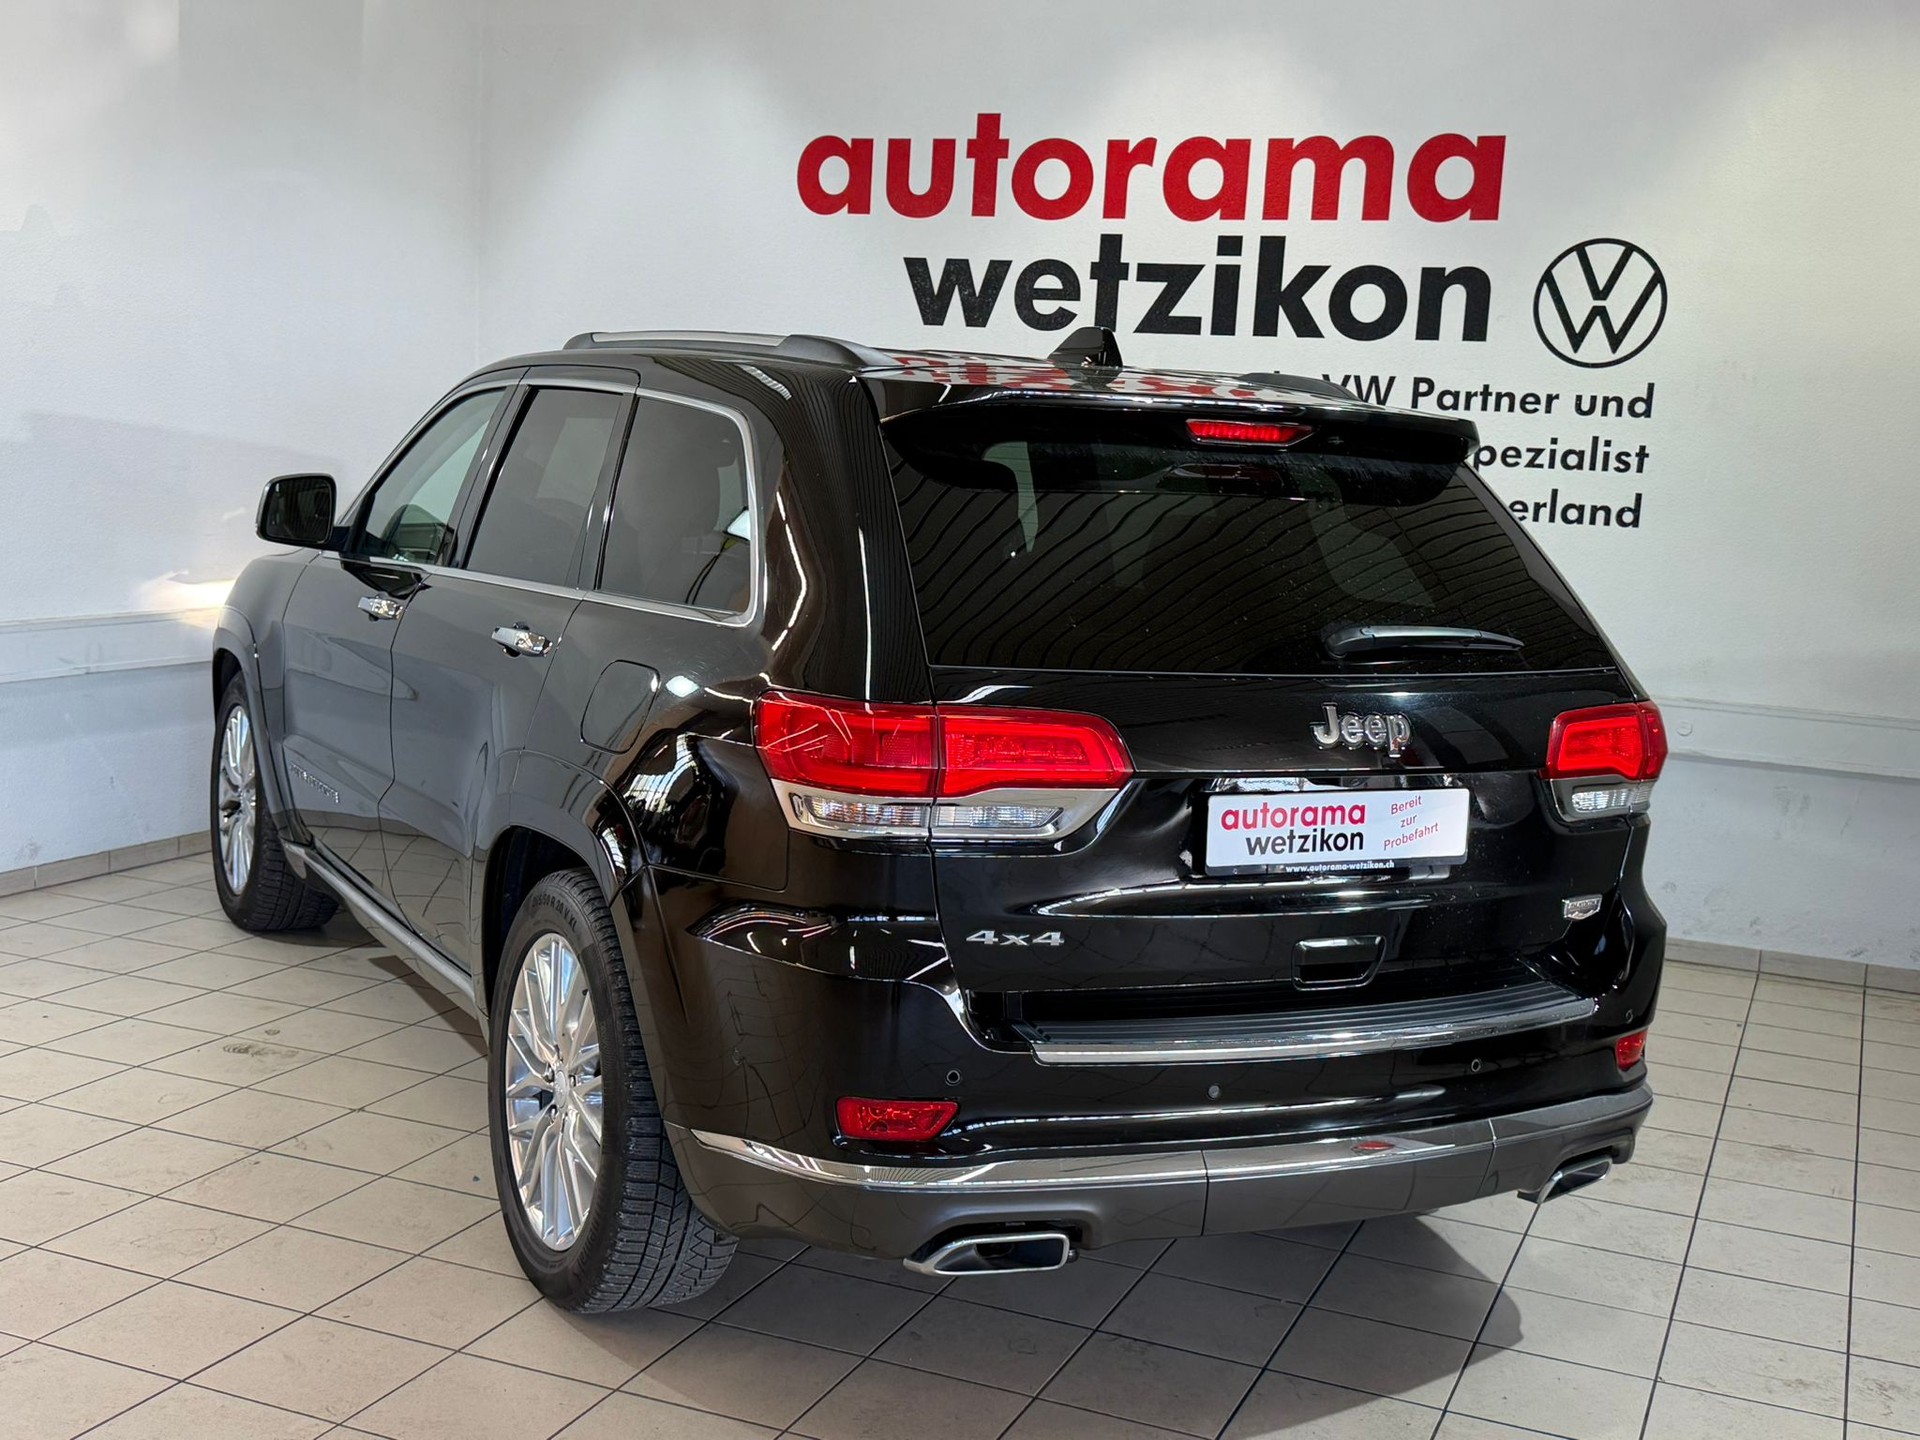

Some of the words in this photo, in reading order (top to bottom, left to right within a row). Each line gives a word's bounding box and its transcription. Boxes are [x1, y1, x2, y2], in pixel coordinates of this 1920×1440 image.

[797, 113, 1506, 223] autorama
[903, 234, 1492, 342] wetzikon
[1411, 376, 1560, 415] Partner
[1574, 382, 1655, 419] und
[1473, 435, 1650, 474] pezialist
[1508, 488, 1643, 528] erland
[1310, 702, 1412, 758] Jeep
[1221, 802, 1366, 830] autorama
[1390, 795, 1423, 815] Bereit
[1400, 814, 1418, 828] zur
[1245, 828, 1364, 856] wetzikon
[1383, 822, 1439, 851] Probefahrt
[1285, 860, 1395, 874] www.autorama-wetzikon.ch
[966, 930, 1065, 946] 4x4
